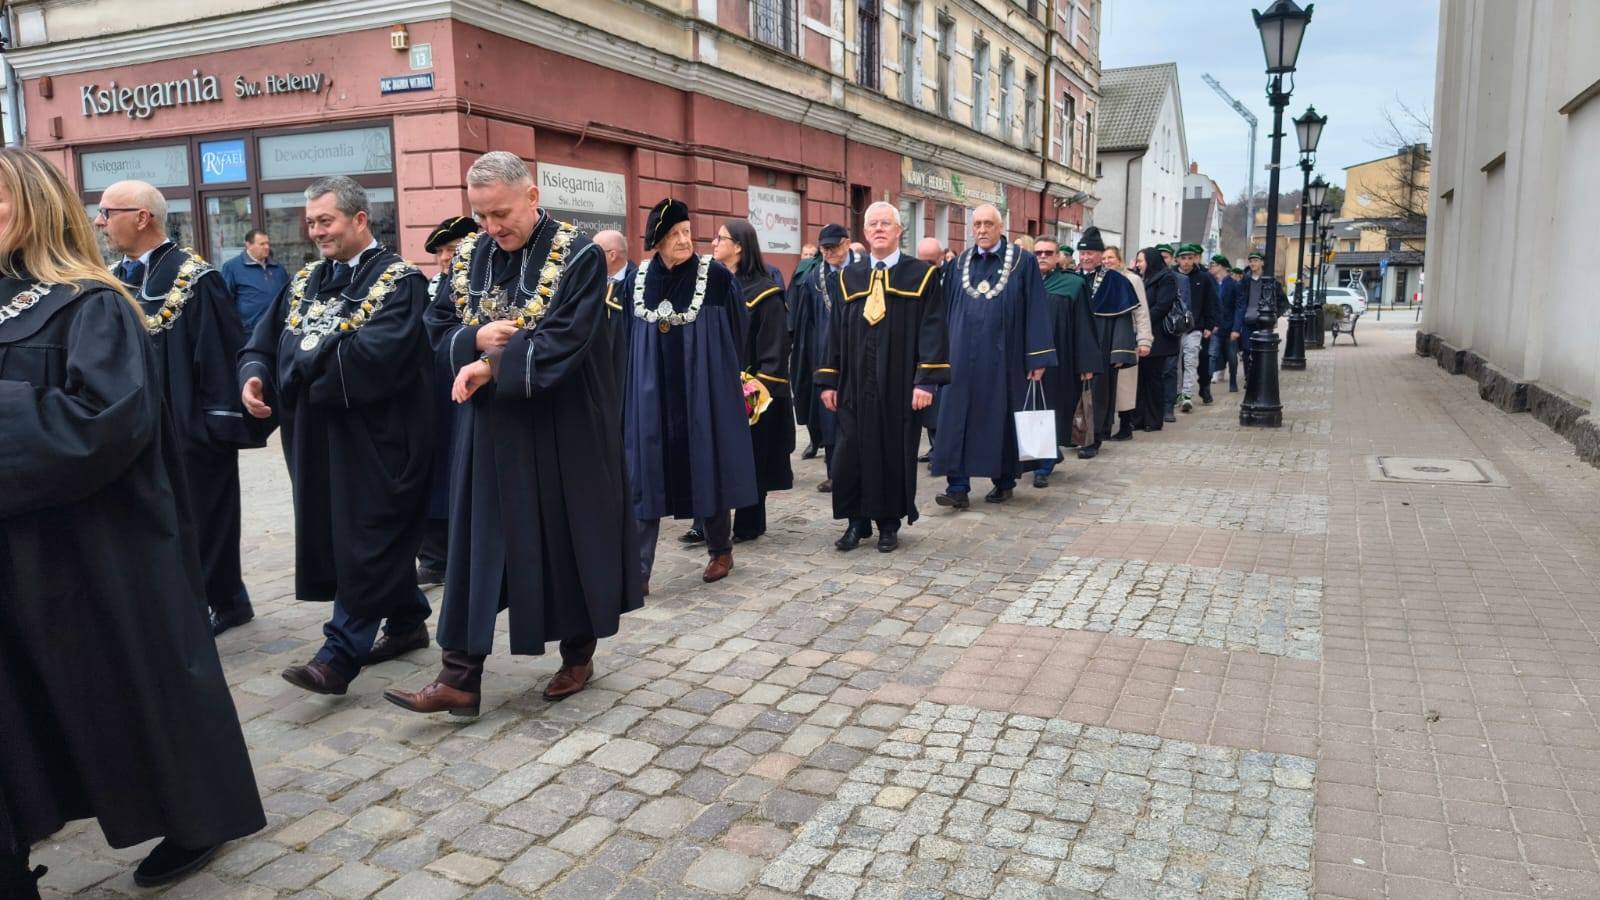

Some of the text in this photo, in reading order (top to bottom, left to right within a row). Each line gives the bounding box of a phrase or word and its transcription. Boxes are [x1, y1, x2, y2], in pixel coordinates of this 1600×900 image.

[79, 69, 321, 118] Księgarnia Św. Heleny
[274, 144, 354, 163] Dewocjonalia
[543, 170, 604, 193] Księgarnia
[573, 218, 621, 232] Dewocjonalia
